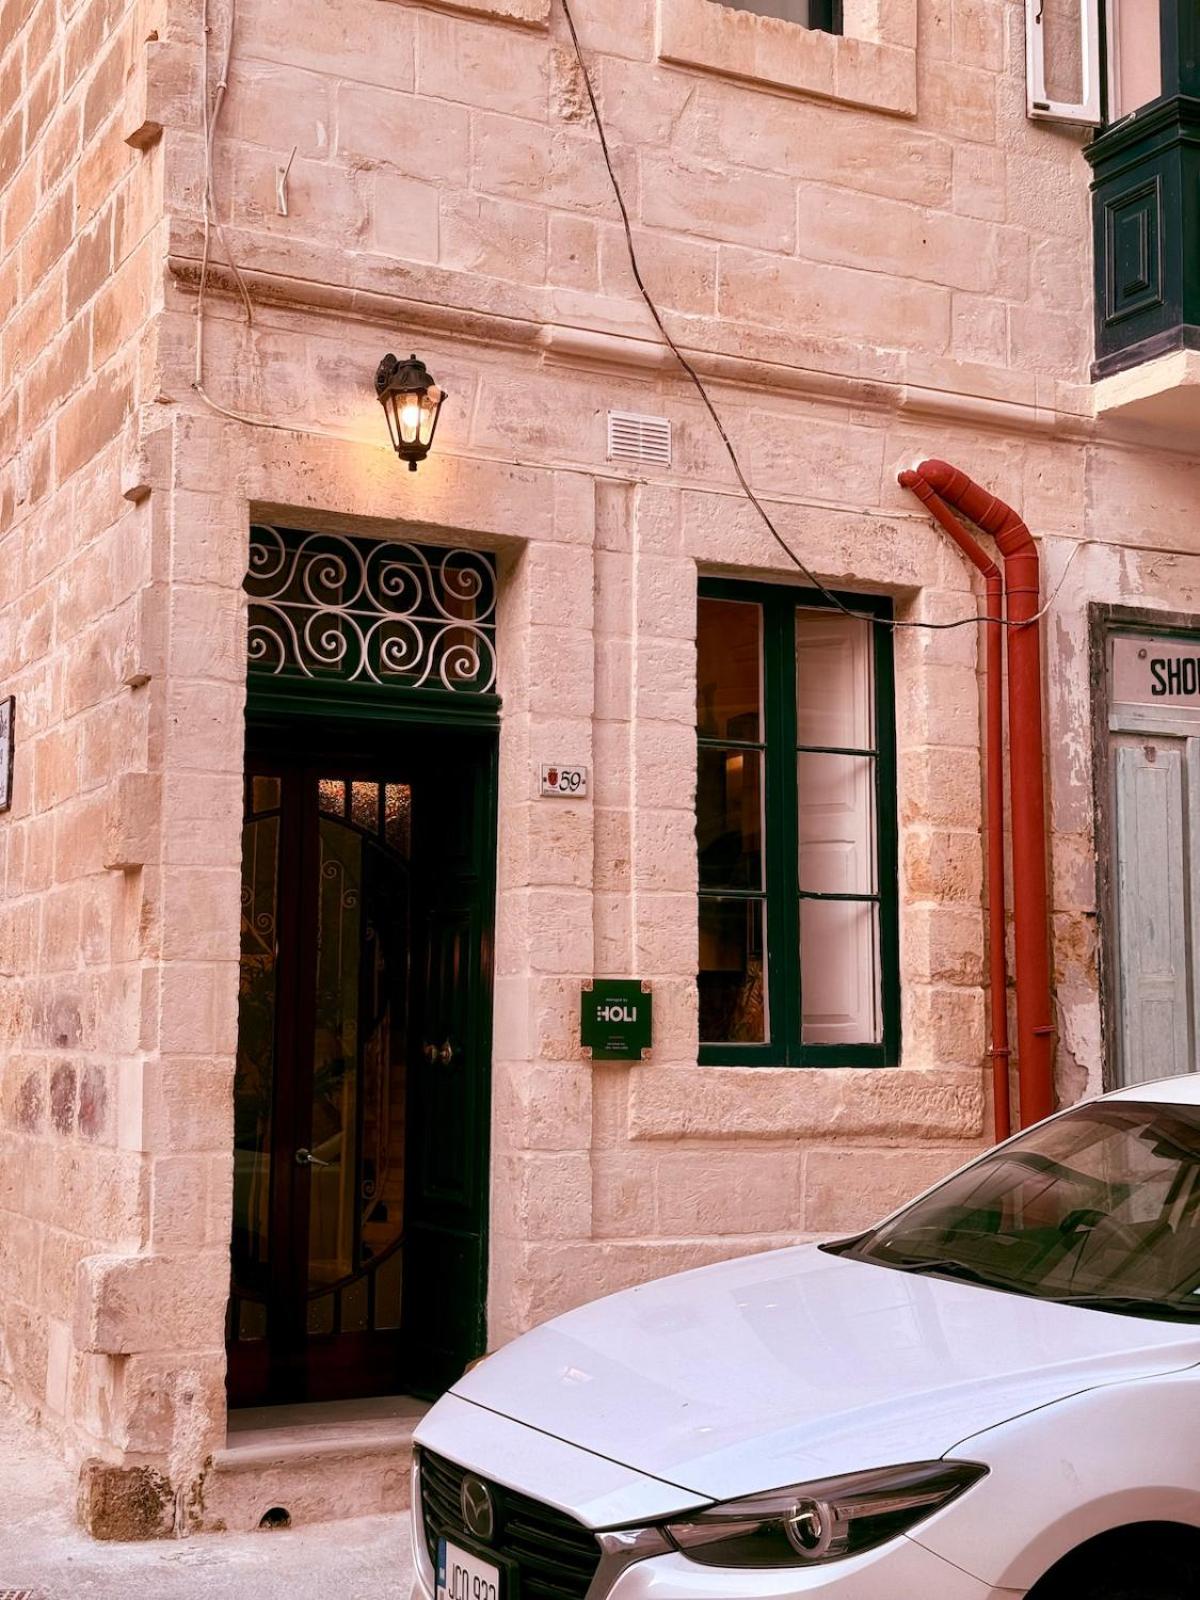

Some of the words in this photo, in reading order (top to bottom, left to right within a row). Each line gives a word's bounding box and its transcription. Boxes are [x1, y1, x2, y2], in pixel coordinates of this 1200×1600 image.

[1150, 657, 1200, 696] SHO
[559, 770, 581, 792] 59
[596, 1005, 637, 1022] HOLI
